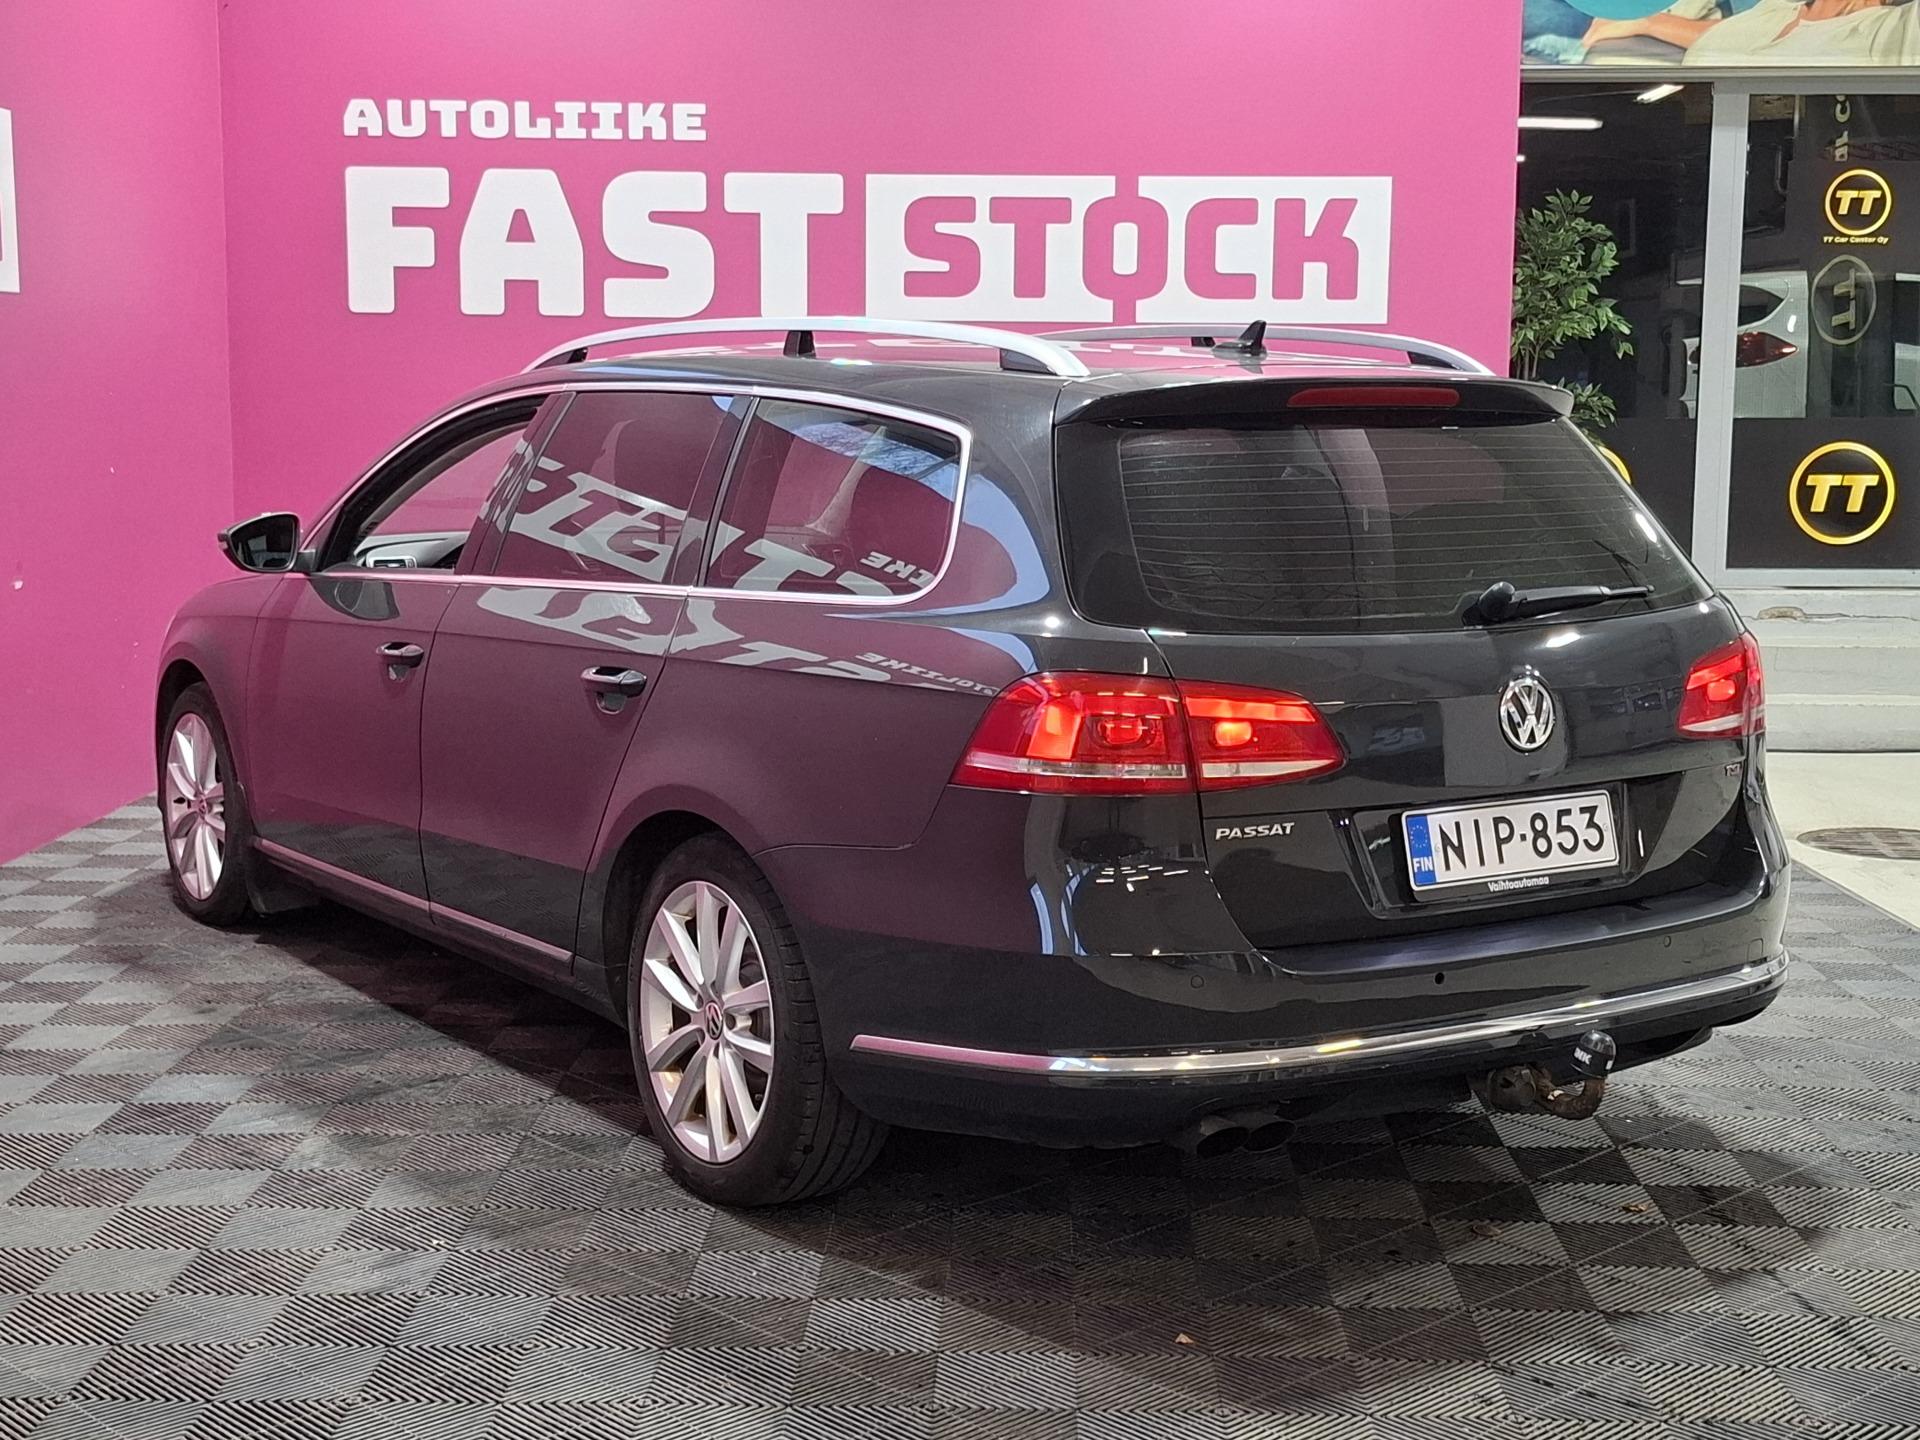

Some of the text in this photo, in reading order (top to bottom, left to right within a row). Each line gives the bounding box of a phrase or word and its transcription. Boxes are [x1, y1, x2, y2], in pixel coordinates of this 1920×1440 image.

[343, 98, 707, 141] AUTOLIIKE
[1836, 190, 1882, 215] TT
[345, 166, 1359, 318] FAST STOCK
[1823, 236, 1834, 244] TT
[1834, 236, 1849, 244] Car
[1876, 236, 1889, 245] Oy
[1806, 474, 1880, 513] TT
[1215, 822, 1295, 841] PASSAT
[1438, 805, 1605, 871] NIP-853
[1413, 855, 1433, 873] FIN
